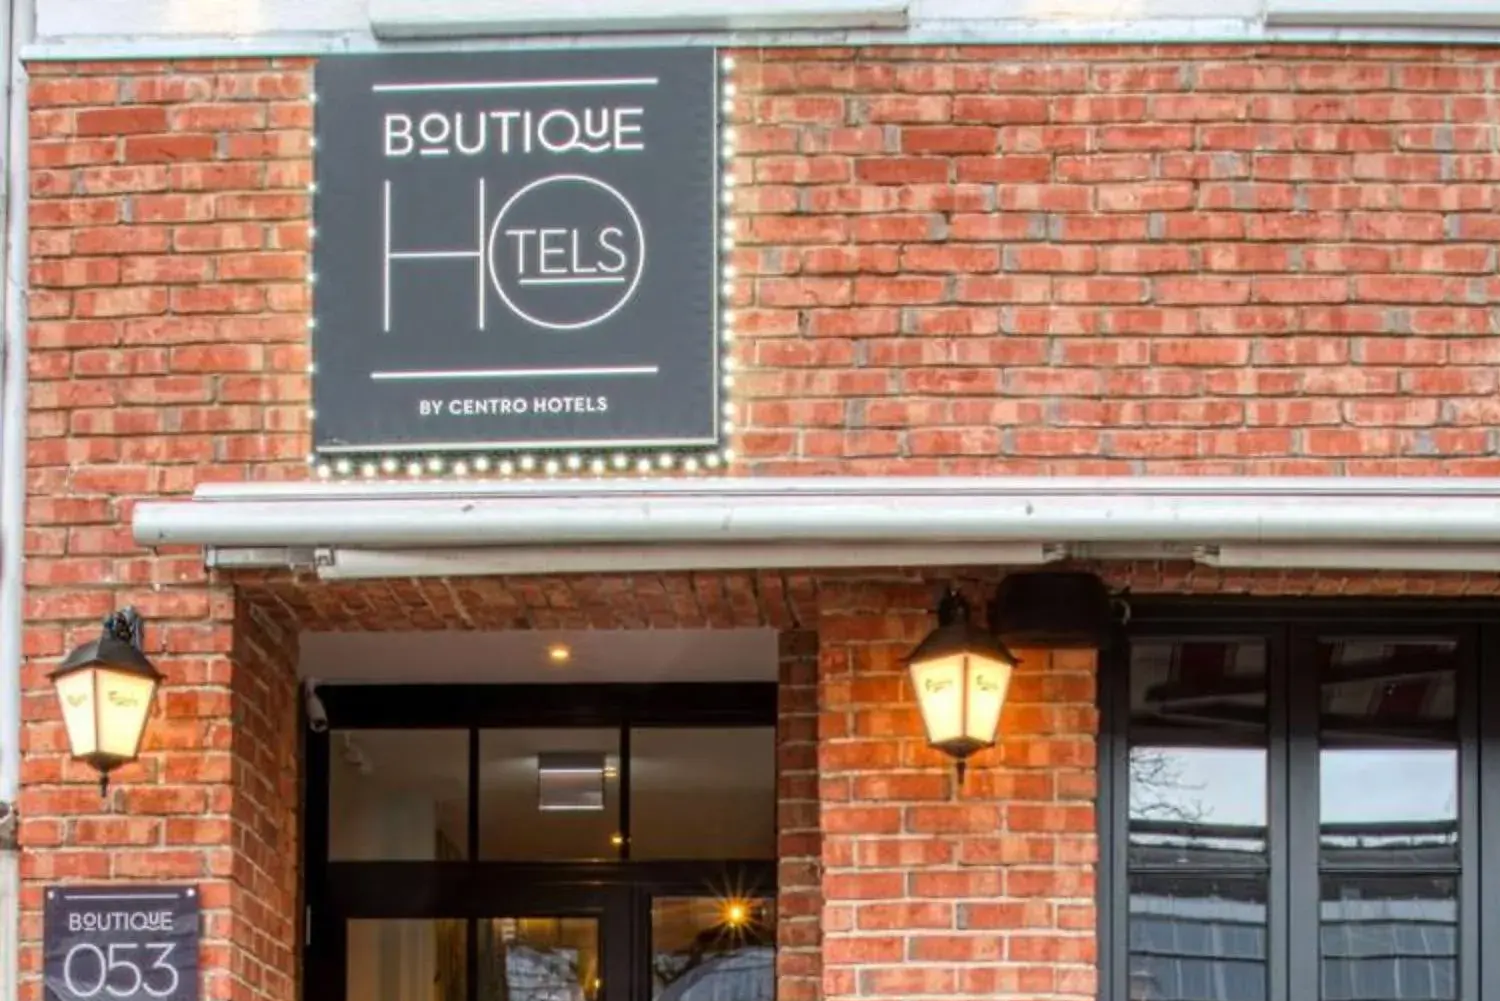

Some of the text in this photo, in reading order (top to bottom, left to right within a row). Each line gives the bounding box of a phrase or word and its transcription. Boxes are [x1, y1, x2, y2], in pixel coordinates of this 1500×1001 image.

[383, 107, 645, 157] BOUTIQUE
[418, 396, 609, 416] BY CENTRO HOTELS
[68, 911, 173, 931] BOUTIQUE
[64, 943, 179, 997] 053
